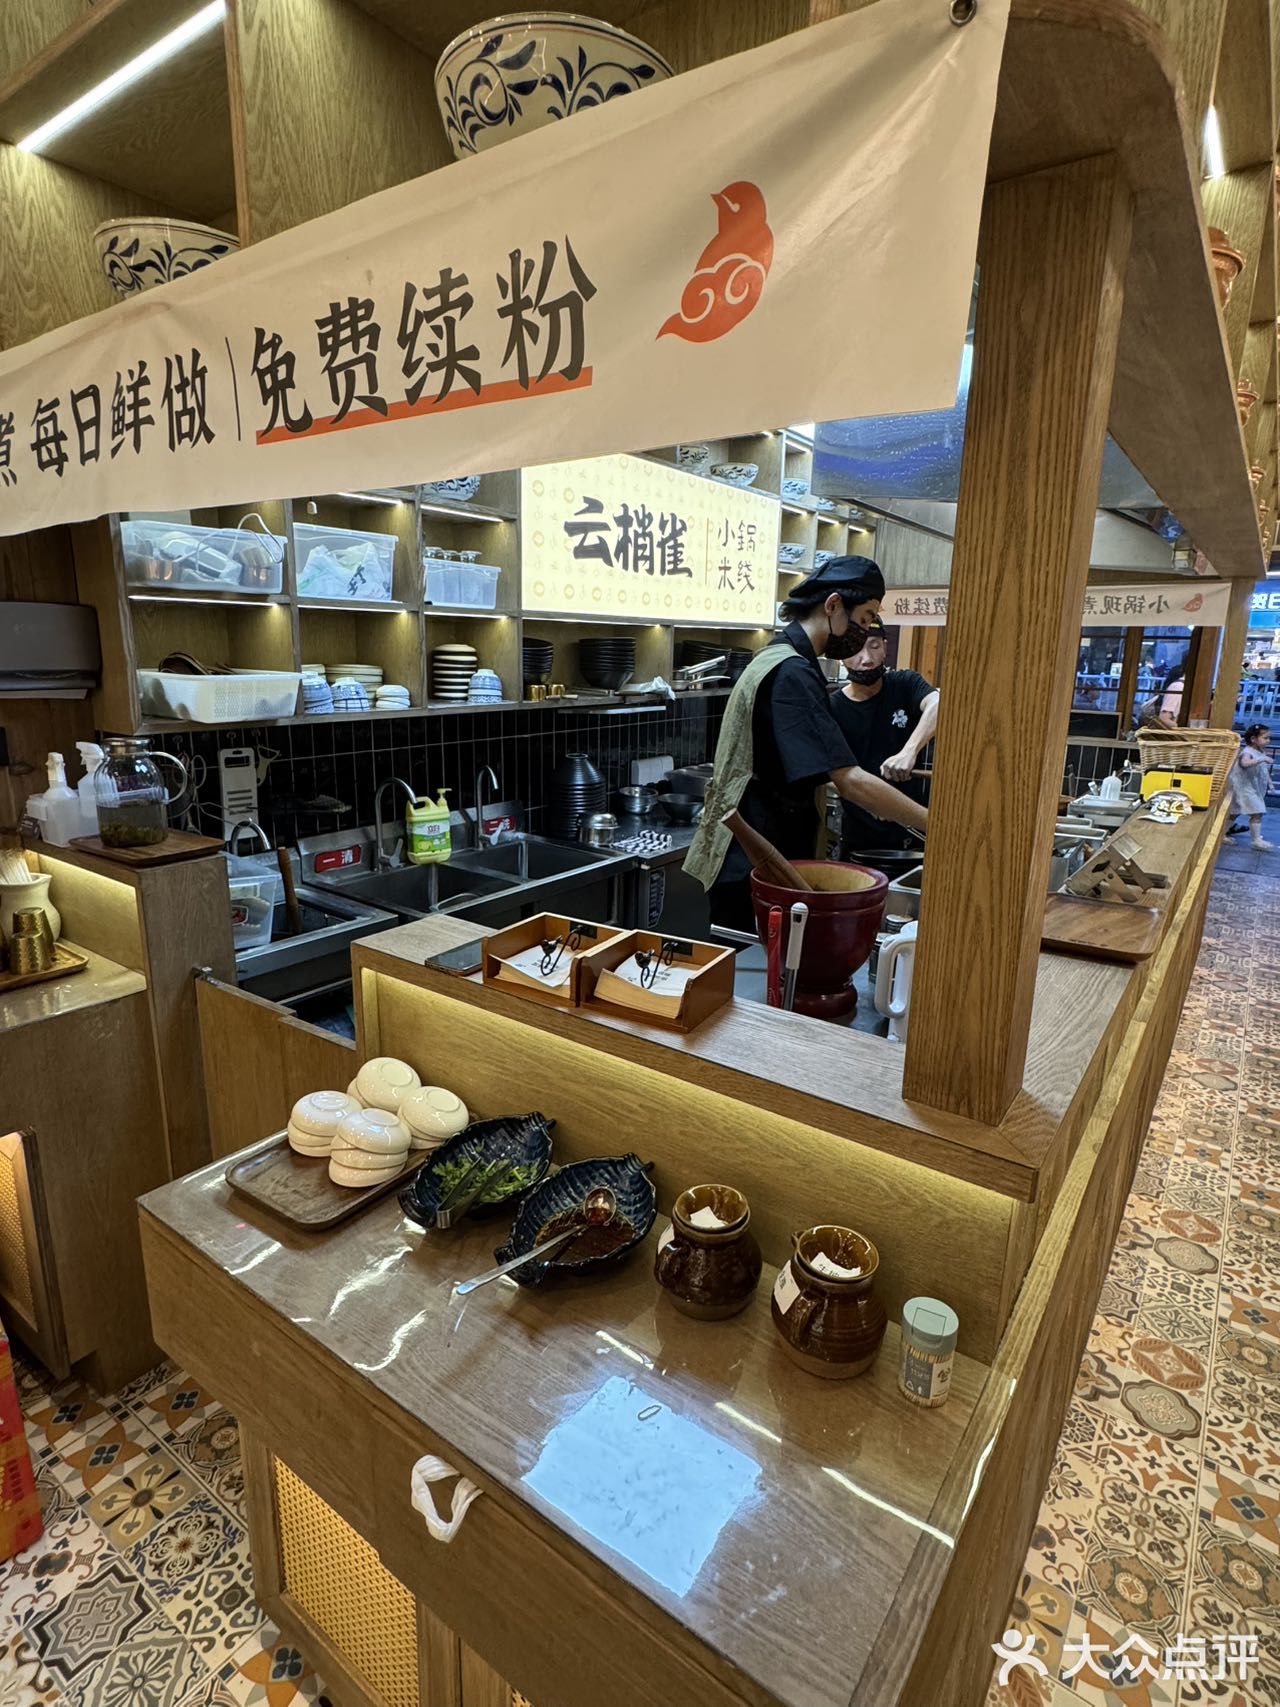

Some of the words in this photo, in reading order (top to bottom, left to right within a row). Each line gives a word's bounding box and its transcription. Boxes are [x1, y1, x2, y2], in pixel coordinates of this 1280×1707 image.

[31, 348, 216, 477] 每日鲜做
[250, 235, 598, 438] 免费续粉
[563, 496, 693, 578] 云梢雀
[717, 556, 756, 594] 米线
